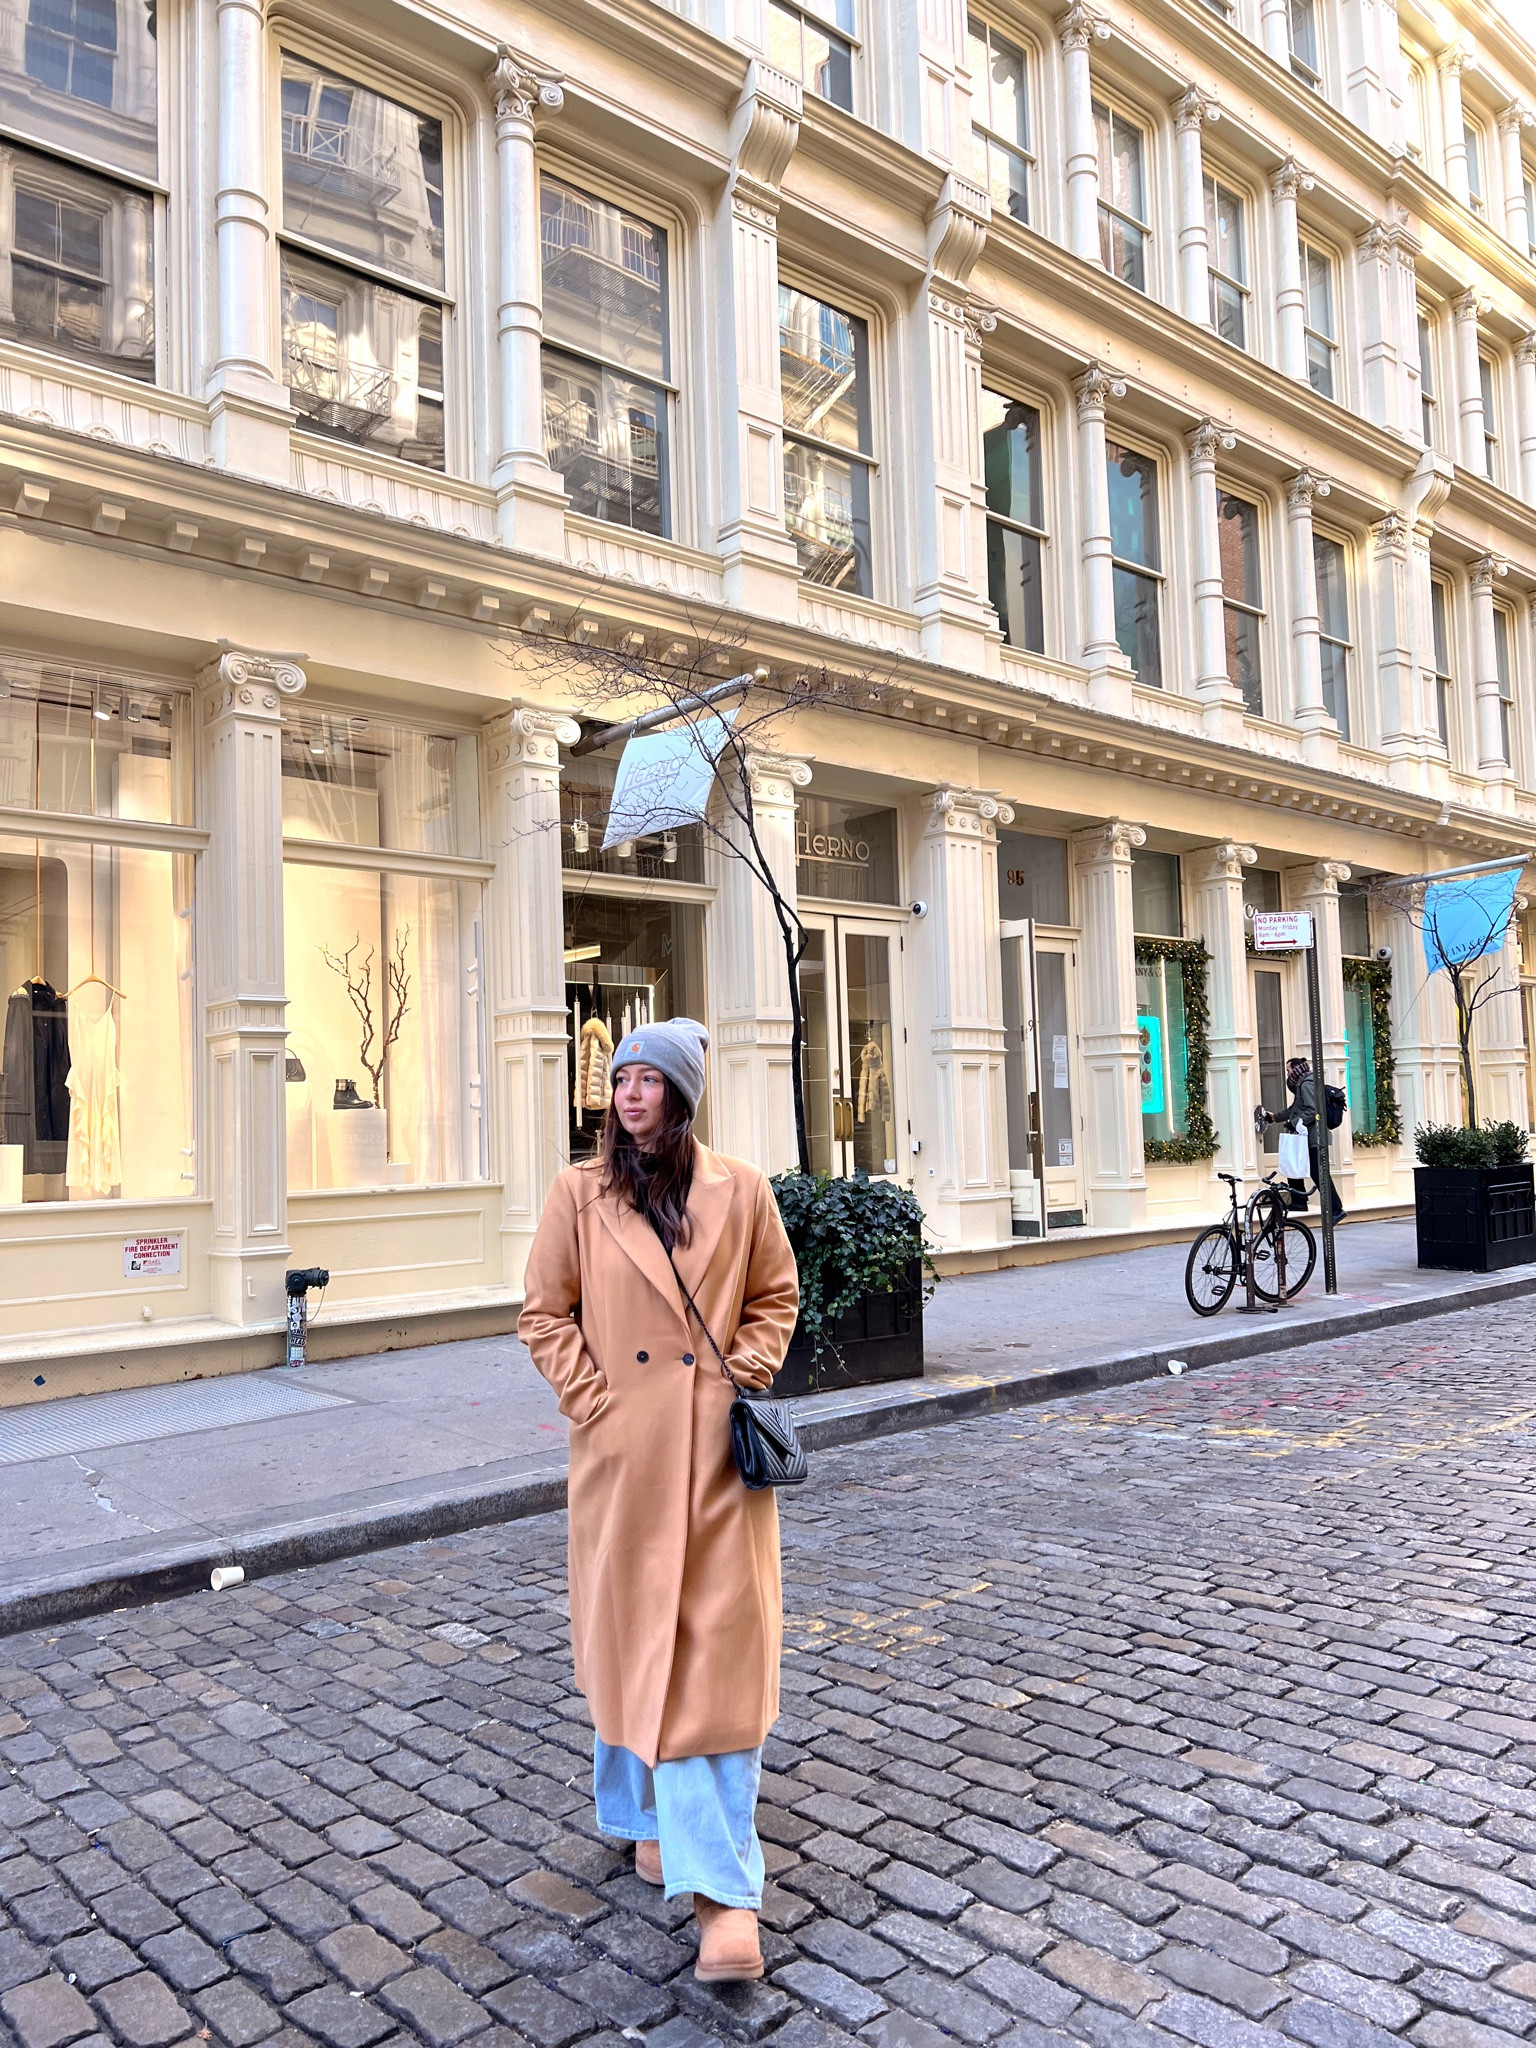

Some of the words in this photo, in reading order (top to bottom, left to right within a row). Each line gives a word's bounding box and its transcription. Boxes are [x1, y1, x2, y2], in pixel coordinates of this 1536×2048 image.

[795, 820, 870, 864] HERNO
[1007, 869, 1025, 886] 95
[1257, 916, 1267, 924] NO
[1269, 915, 1298, 923] PARKING
[135, 1237, 168, 1245] SPRINKLER
[140, 1243, 178, 1252] DEPARTMENT
[133, 1251, 171, 1259] CONNECTION
